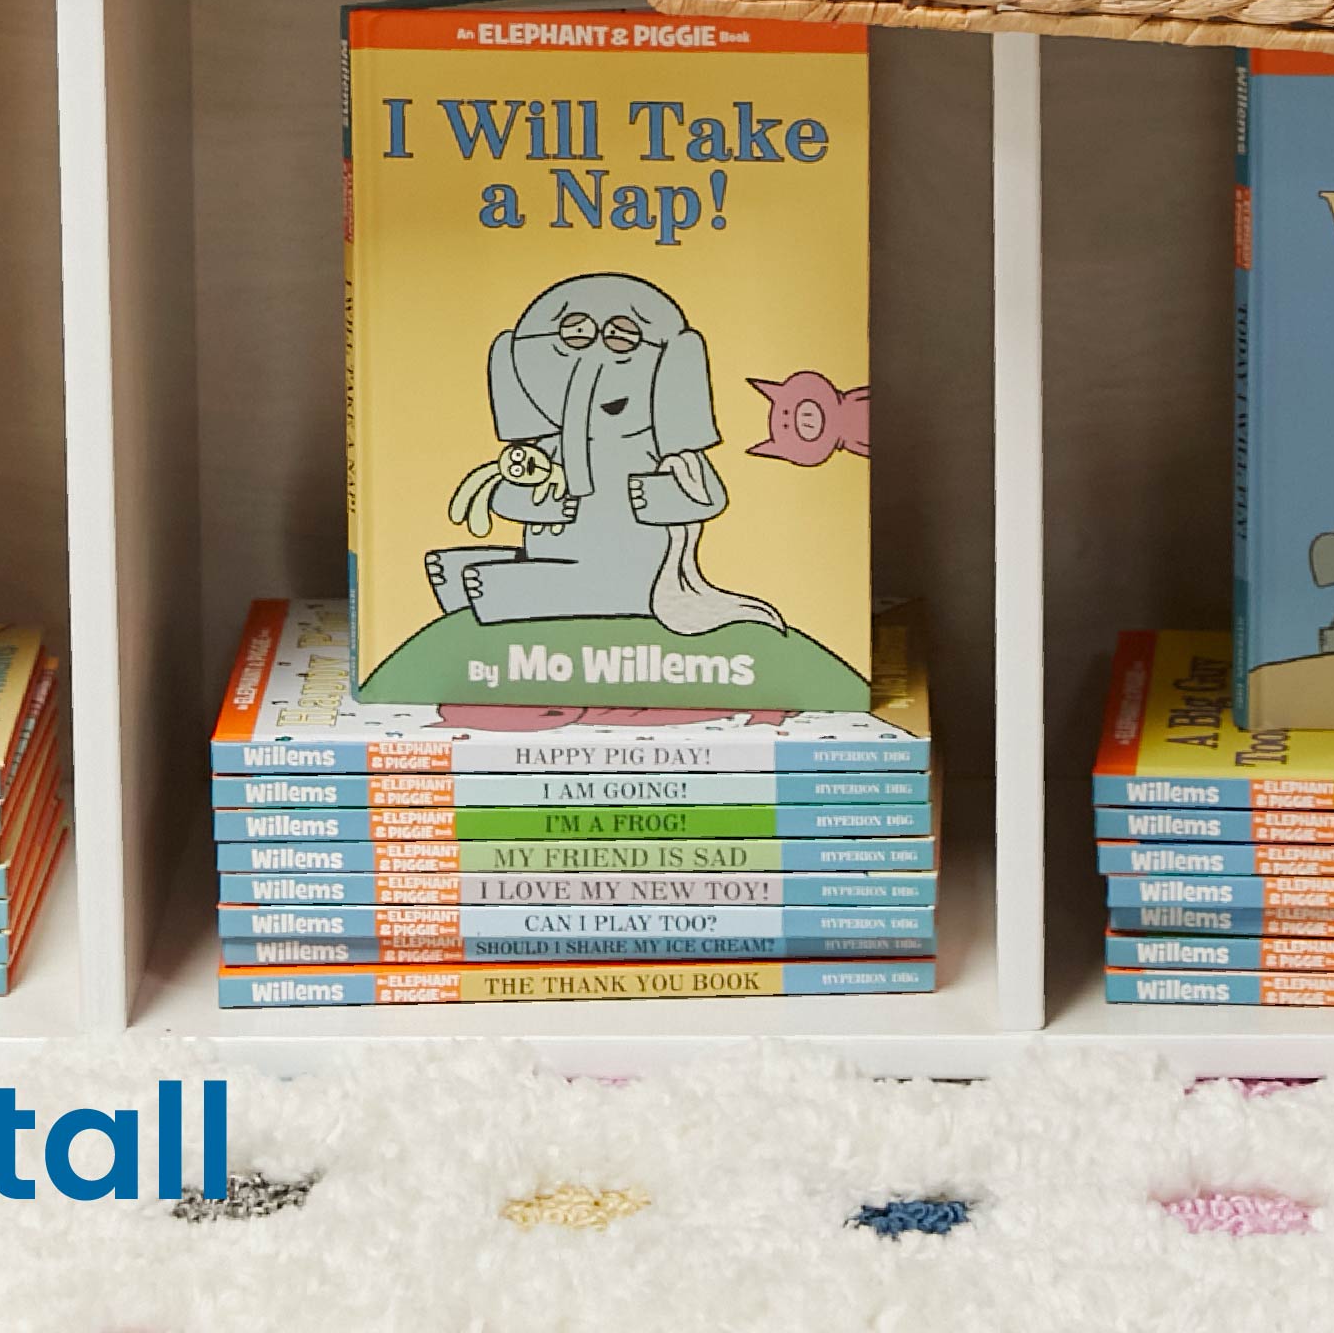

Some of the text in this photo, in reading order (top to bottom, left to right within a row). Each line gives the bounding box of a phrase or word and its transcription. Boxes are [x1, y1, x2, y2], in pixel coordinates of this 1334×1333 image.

[457, 23, 750, 47] An ELEPHANT & PIGGIE Book
[382, 98, 830, 163] I Will Take
[479, 168, 728, 246] a Nap!
[468, 644, 756, 688] By Mo Willems
[244, 747, 335, 766] Willems
[517, 748, 709, 765] HAPPY PIG DAY!
[246, 782, 336, 803] Willems
[561, 783, 593, 799] AM
[604, 783, 686, 799] GOING!
[1127, 782, 1219, 803] Willems
[546, 815, 685, 834] I'M A FROG!
[495, 847, 746, 868] MY FRIEND IS SAD
[1132, 851, 1223, 871] Willems
[252, 880, 344, 899] Willems
[499, 882, 570, 901] LOVE
[582, 882, 620, 901] MY
[632, 882, 694, 900] NEW
[705, 882, 768, 900] TOY!
[1140, 881, 1232, 901] Willems
[252, 914, 344, 933] Willems
[525, 915, 570, 932] CAN
[595, 915, 651, 932] PLAY
[659, 915, 716, 932] TOO?
[1138, 942, 1228, 963] Willems
[252, 981, 343, 1002] Willems
[485, 973, 759, 995] THE THANK YOU BOOK
[1137, 980, 1229, 1002] Willems
